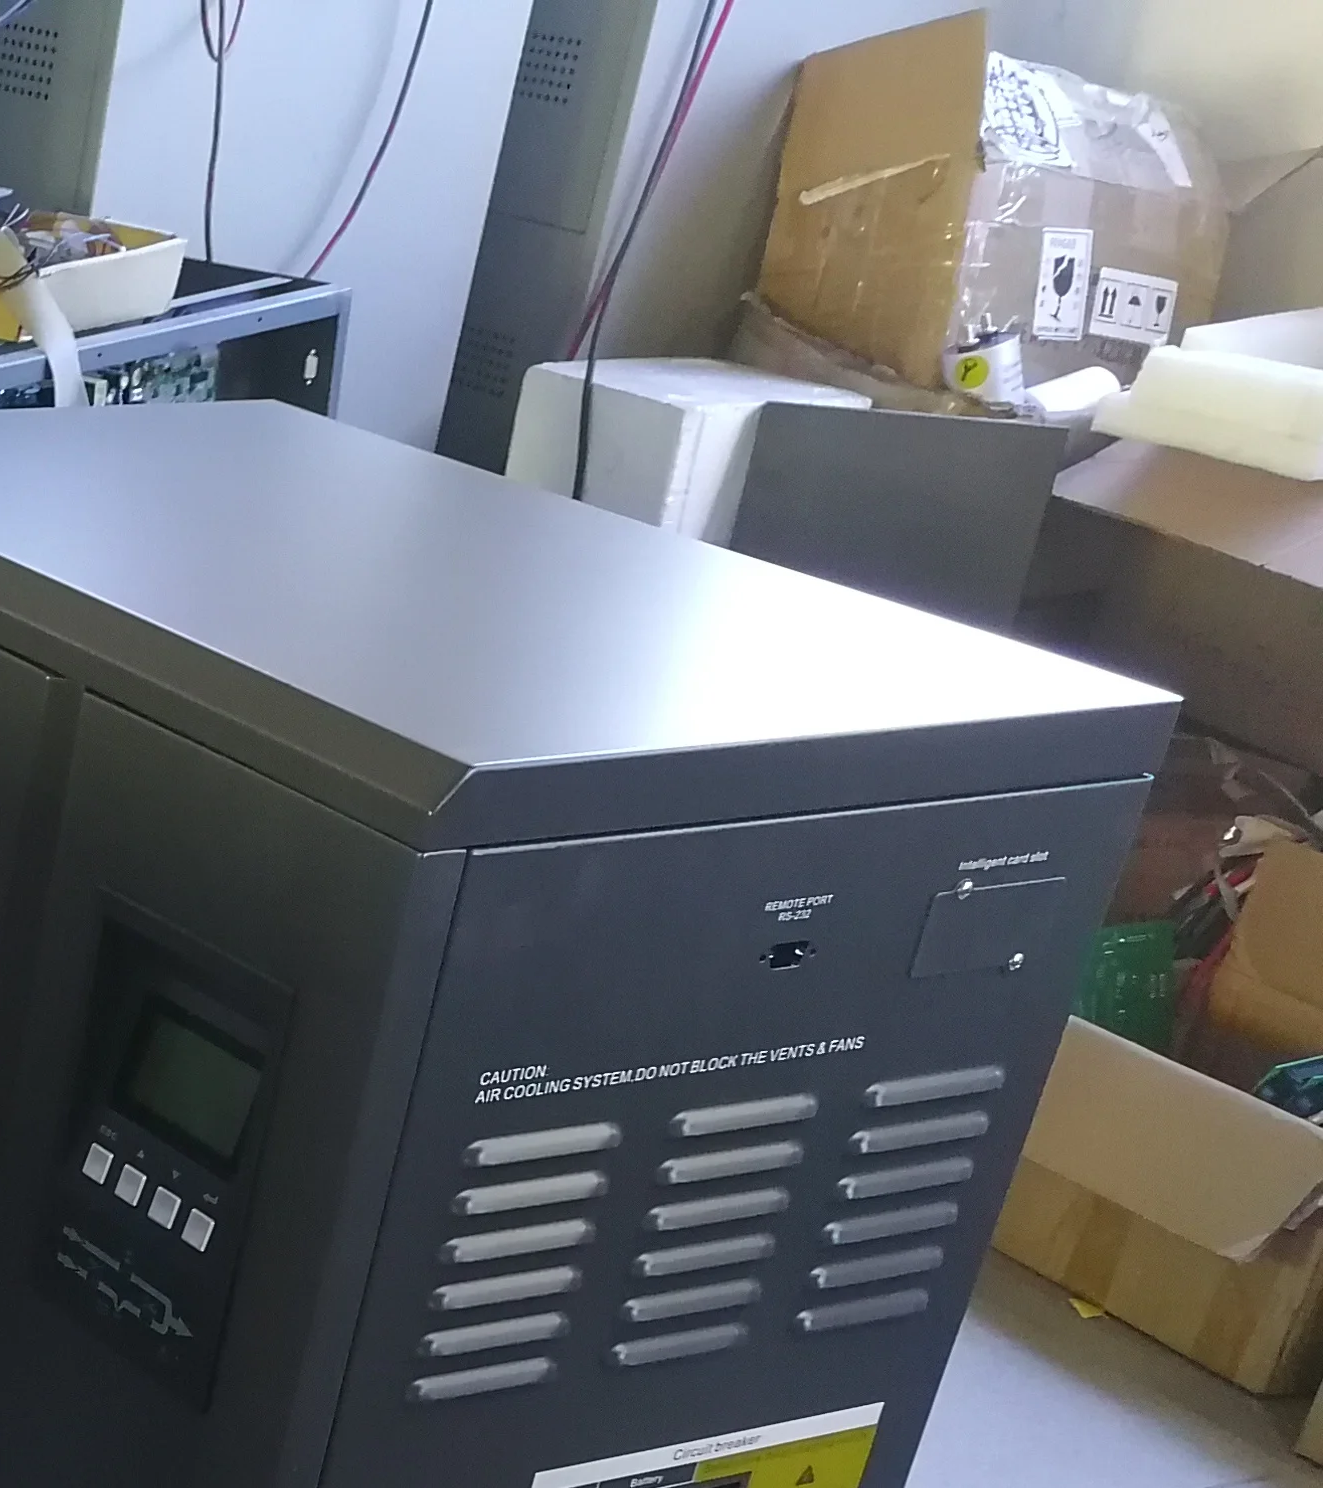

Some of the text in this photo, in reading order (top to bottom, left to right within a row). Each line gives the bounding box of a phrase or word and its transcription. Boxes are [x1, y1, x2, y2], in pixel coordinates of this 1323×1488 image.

[764, 894, 834, 911] REMOTE PORT
[778, 909, 812, 921] RS-232
[475, 1088, 502, 1104] AIR
[504, 1078, 571, 1100] COOLING
[658, 1061, 690, 1078] NOT
[690, 1054, 739, 1073] BLOCK
[740, 1050, 768, 1066] THE
[770, 1043, 816, 1062] VENTS
[816, 1041, 826, 1055] &
[829, 1036, 866, 1053] FANS
[673, 1445, 714, 1461] Circuit
[714, 1434, 762, 1452] breaker
[630, 1475, 664, 1488] Battery
